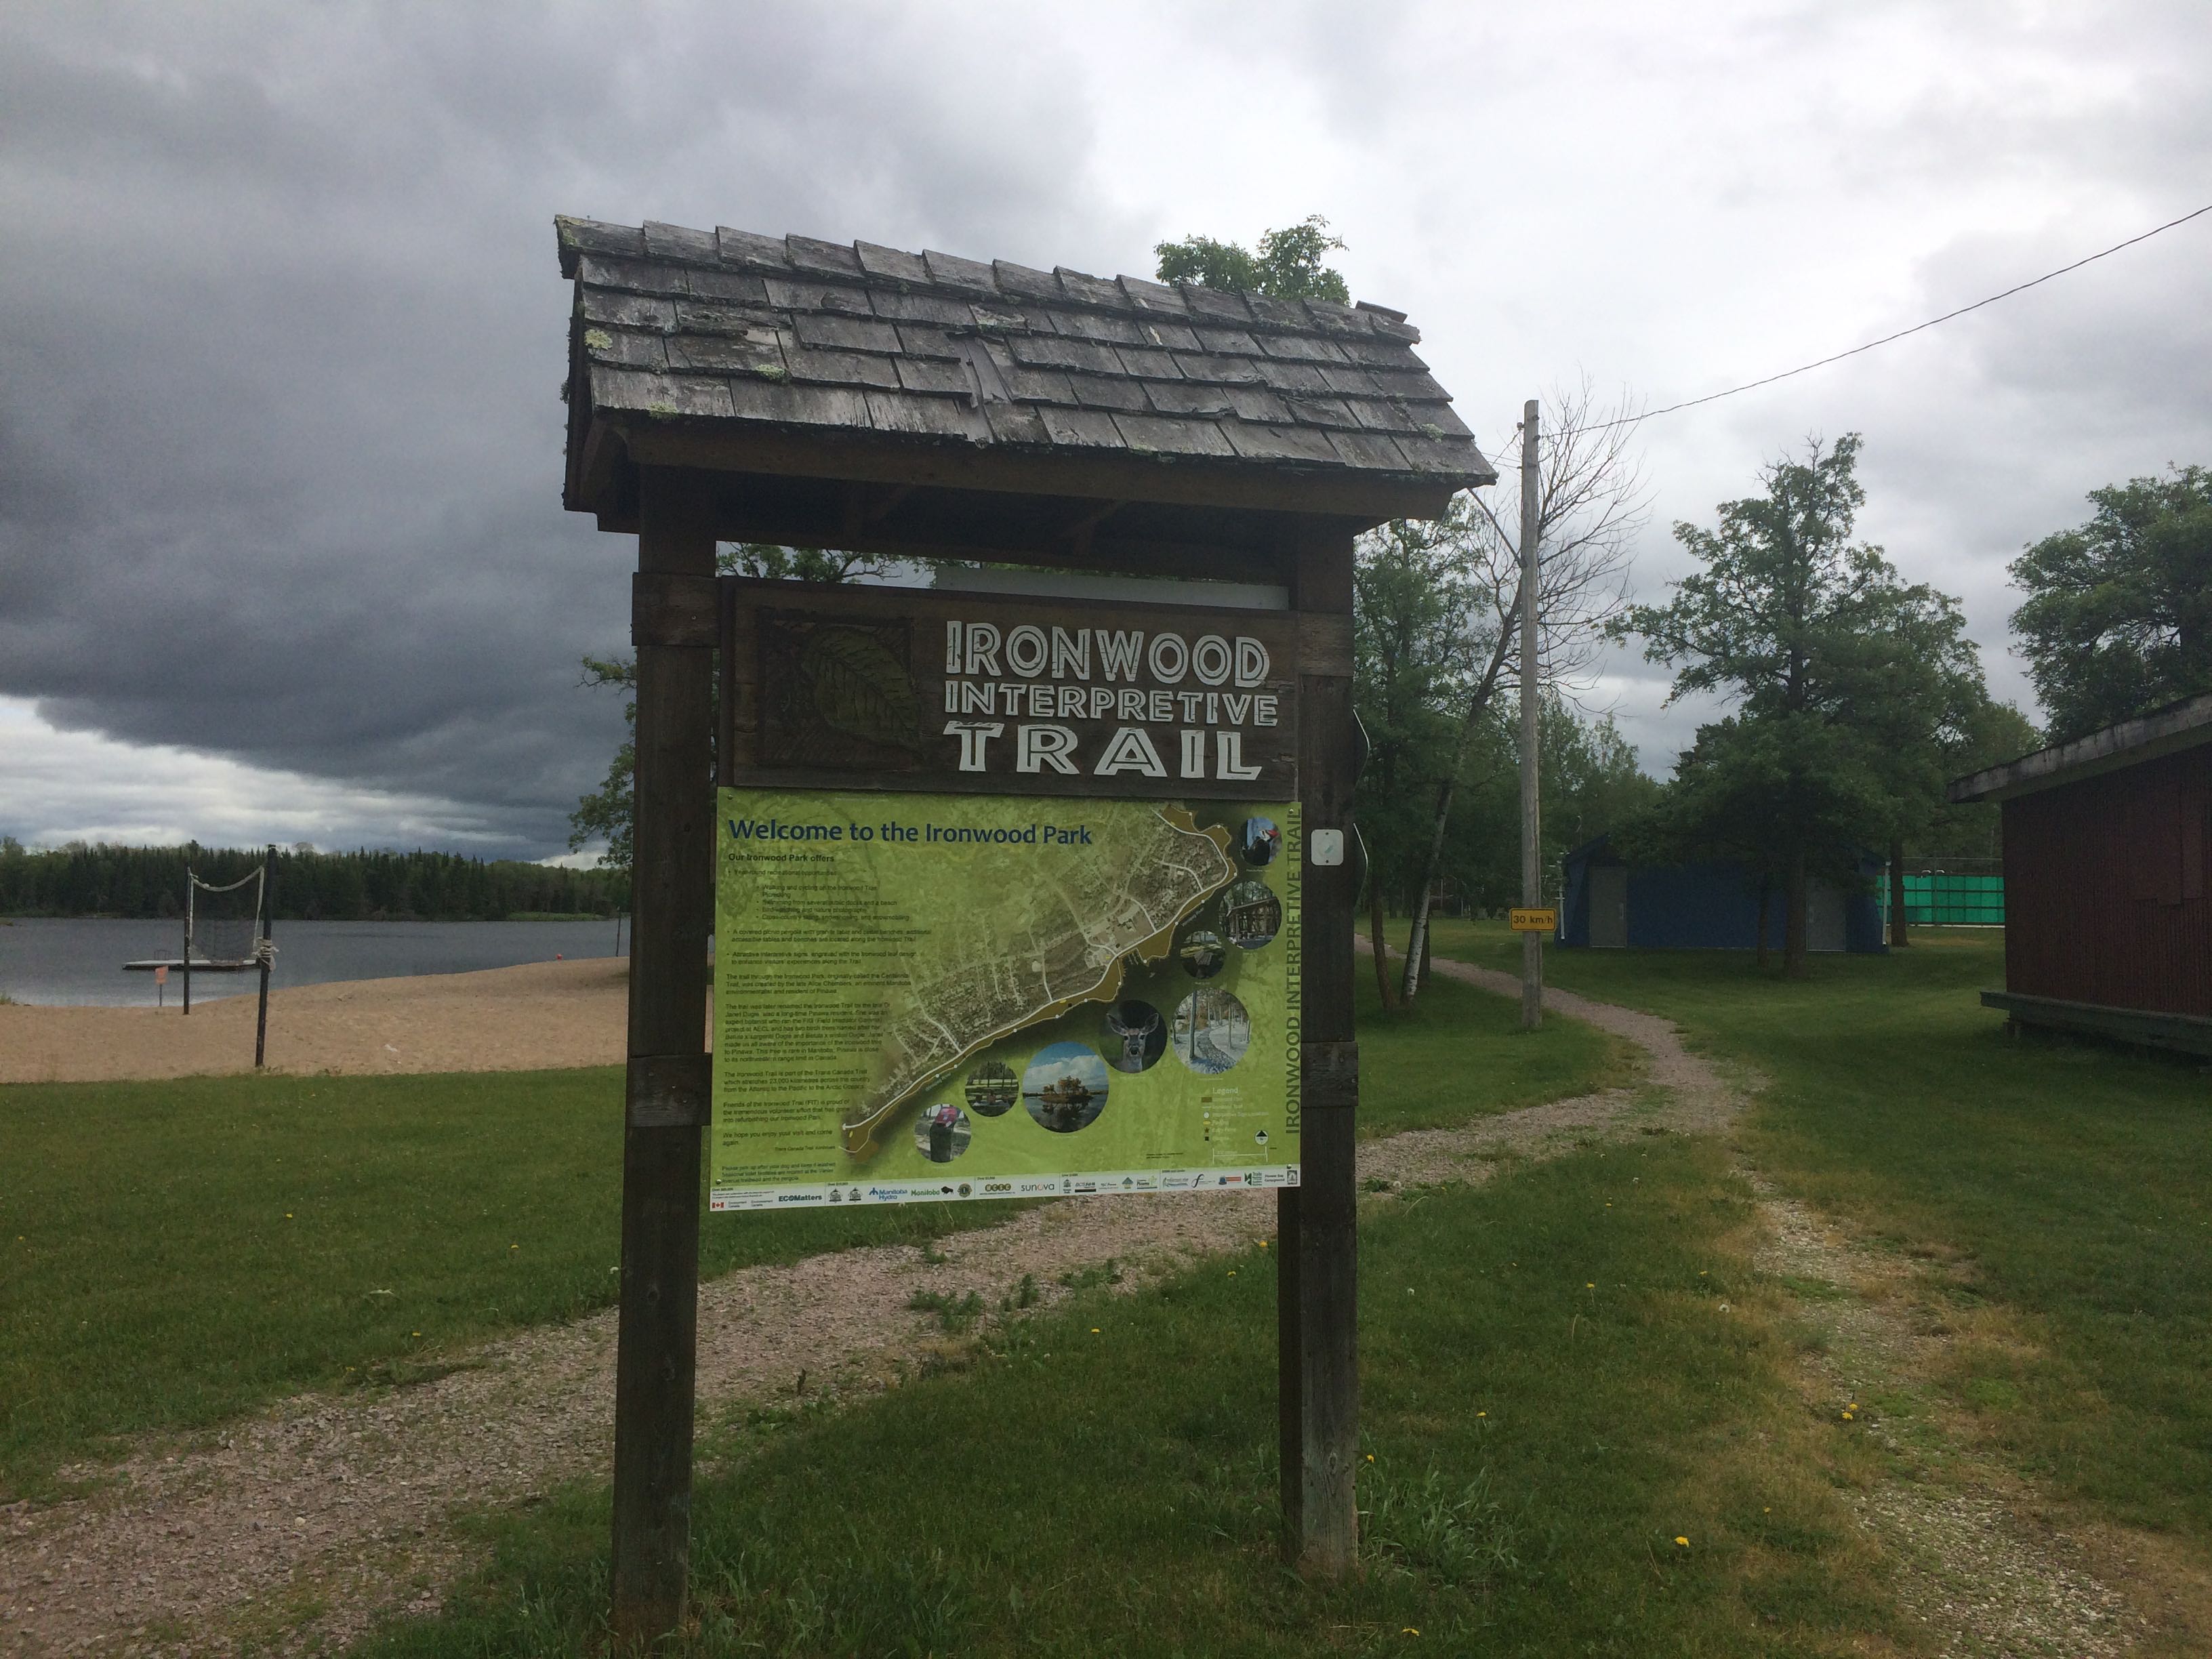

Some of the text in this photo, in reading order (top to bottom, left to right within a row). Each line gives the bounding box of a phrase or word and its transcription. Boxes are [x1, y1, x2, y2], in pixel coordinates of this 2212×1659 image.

[945, 621, 1269, 688] IRONWOOD
[945, 680, 1278, 726] INTERPRETIVE
[943, 720, 1263, 781] TRAIL
[729, 819, 1092, 844] Welcome to the Ironwood Park
[1530, 916, 1553, 924] km/h
[1286, 808, 1301, 1134] IRONWOOD INTERPRETIVE TRAIL
[1212, 1087, 1239, 1095] Legend
[1021, 1183, 1054, 1191] sunova
